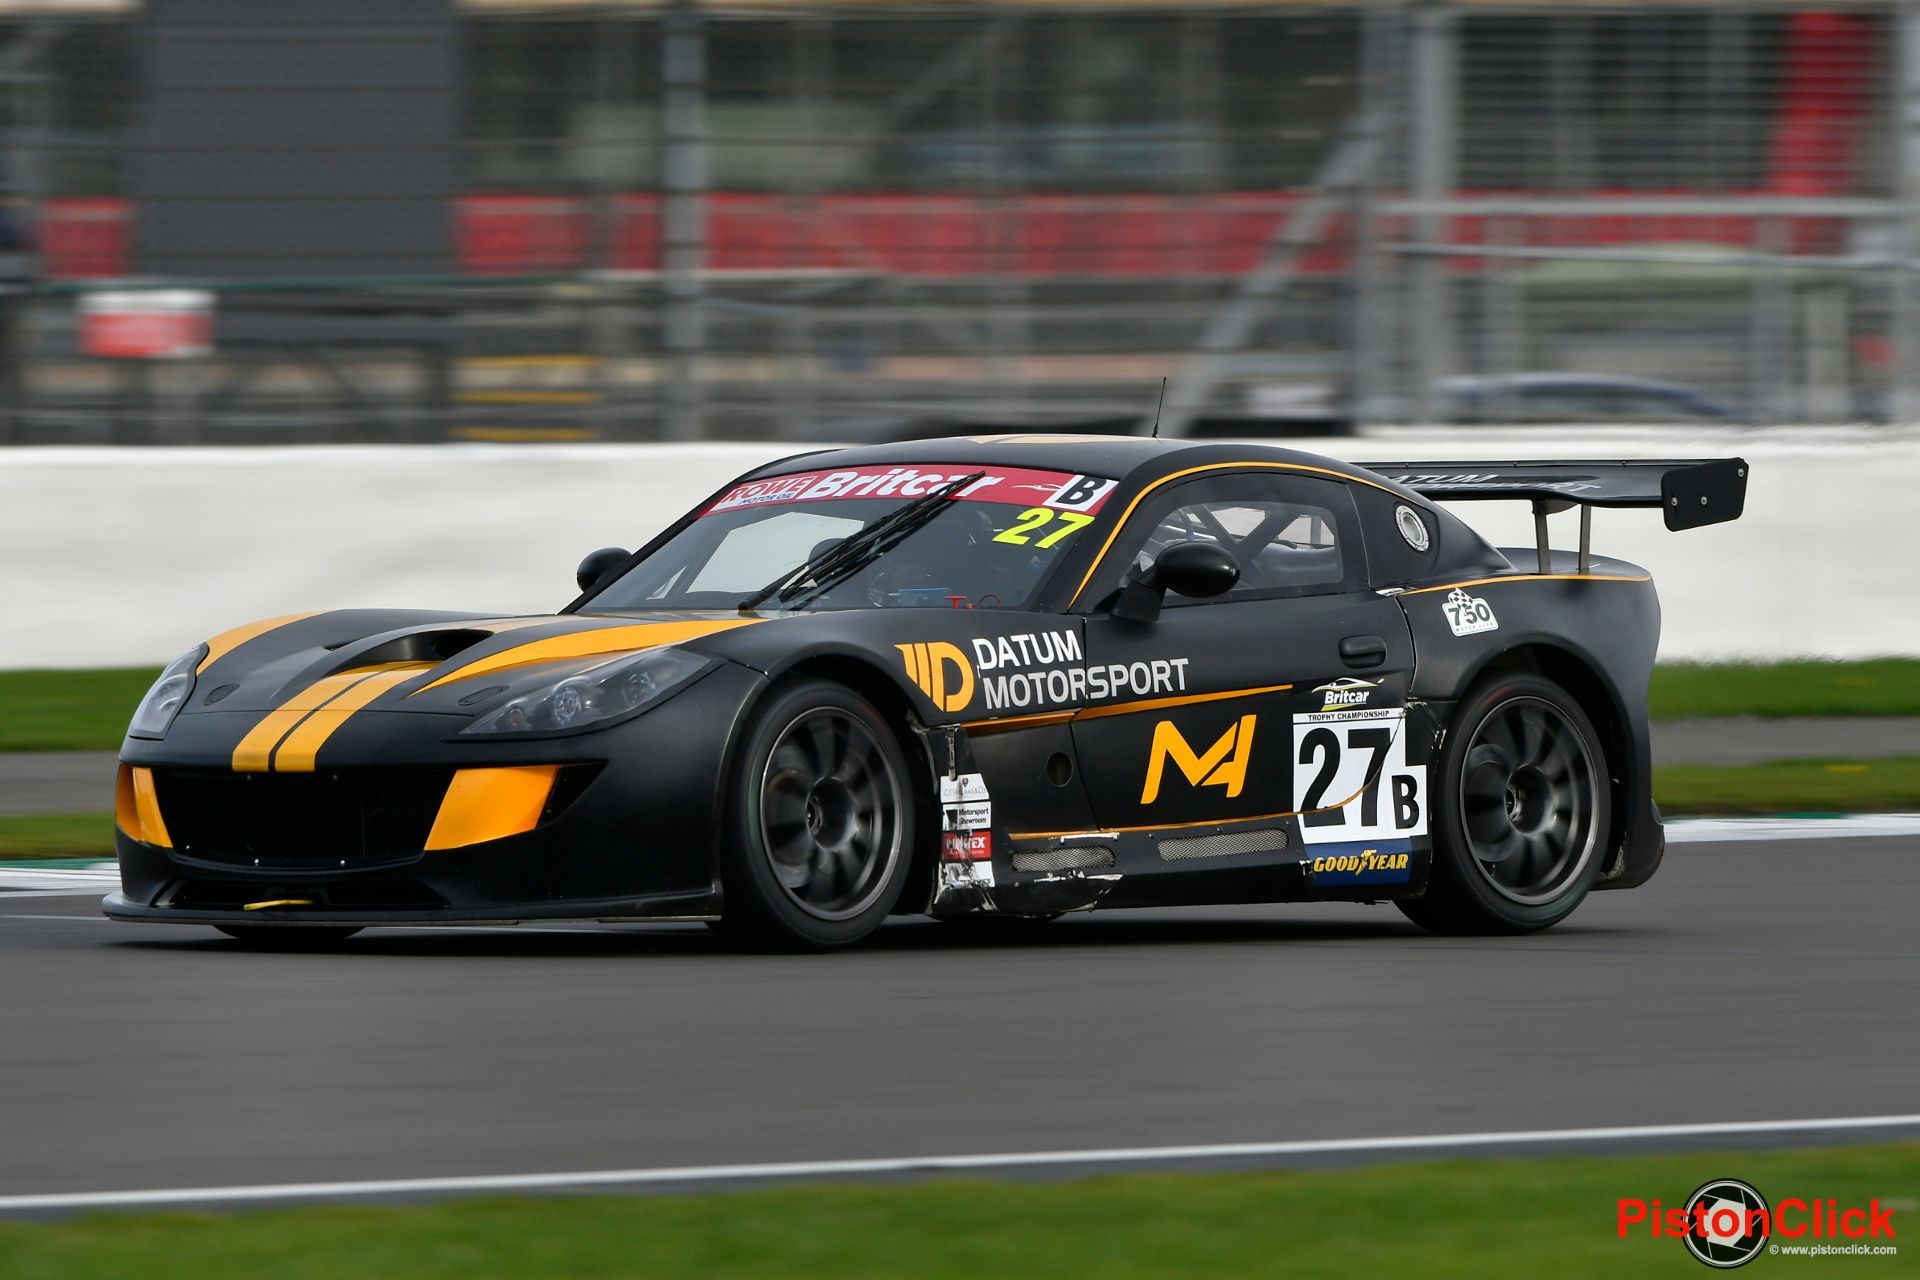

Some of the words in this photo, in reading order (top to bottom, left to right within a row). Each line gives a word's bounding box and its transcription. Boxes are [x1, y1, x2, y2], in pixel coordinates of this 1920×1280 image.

[720, 476, 817, 503] ROWE
[739, 495, 775, 504] MOTOR
[1055, 475, 1107, 505] B
[992, 508, 1096, 549] 27
[1448, 603, 1490, 626] 750
[972, 630, 1082, 670] DATUM
[983, 658, 1189, 710] MOTORSPORT
[1324, 690, 1370, 704] Britcar
[1308, 713, 1335, 722] TROPHY
[1337, 710, 1390, 720] CHAMPIONSHIP
[1299, 727, 1391, 828] 27
[959, 808, 990, 817] Motorsport
[1392, 774, 1420, 830] B
[1313, 852, 1409, 873] GOODYEAR
